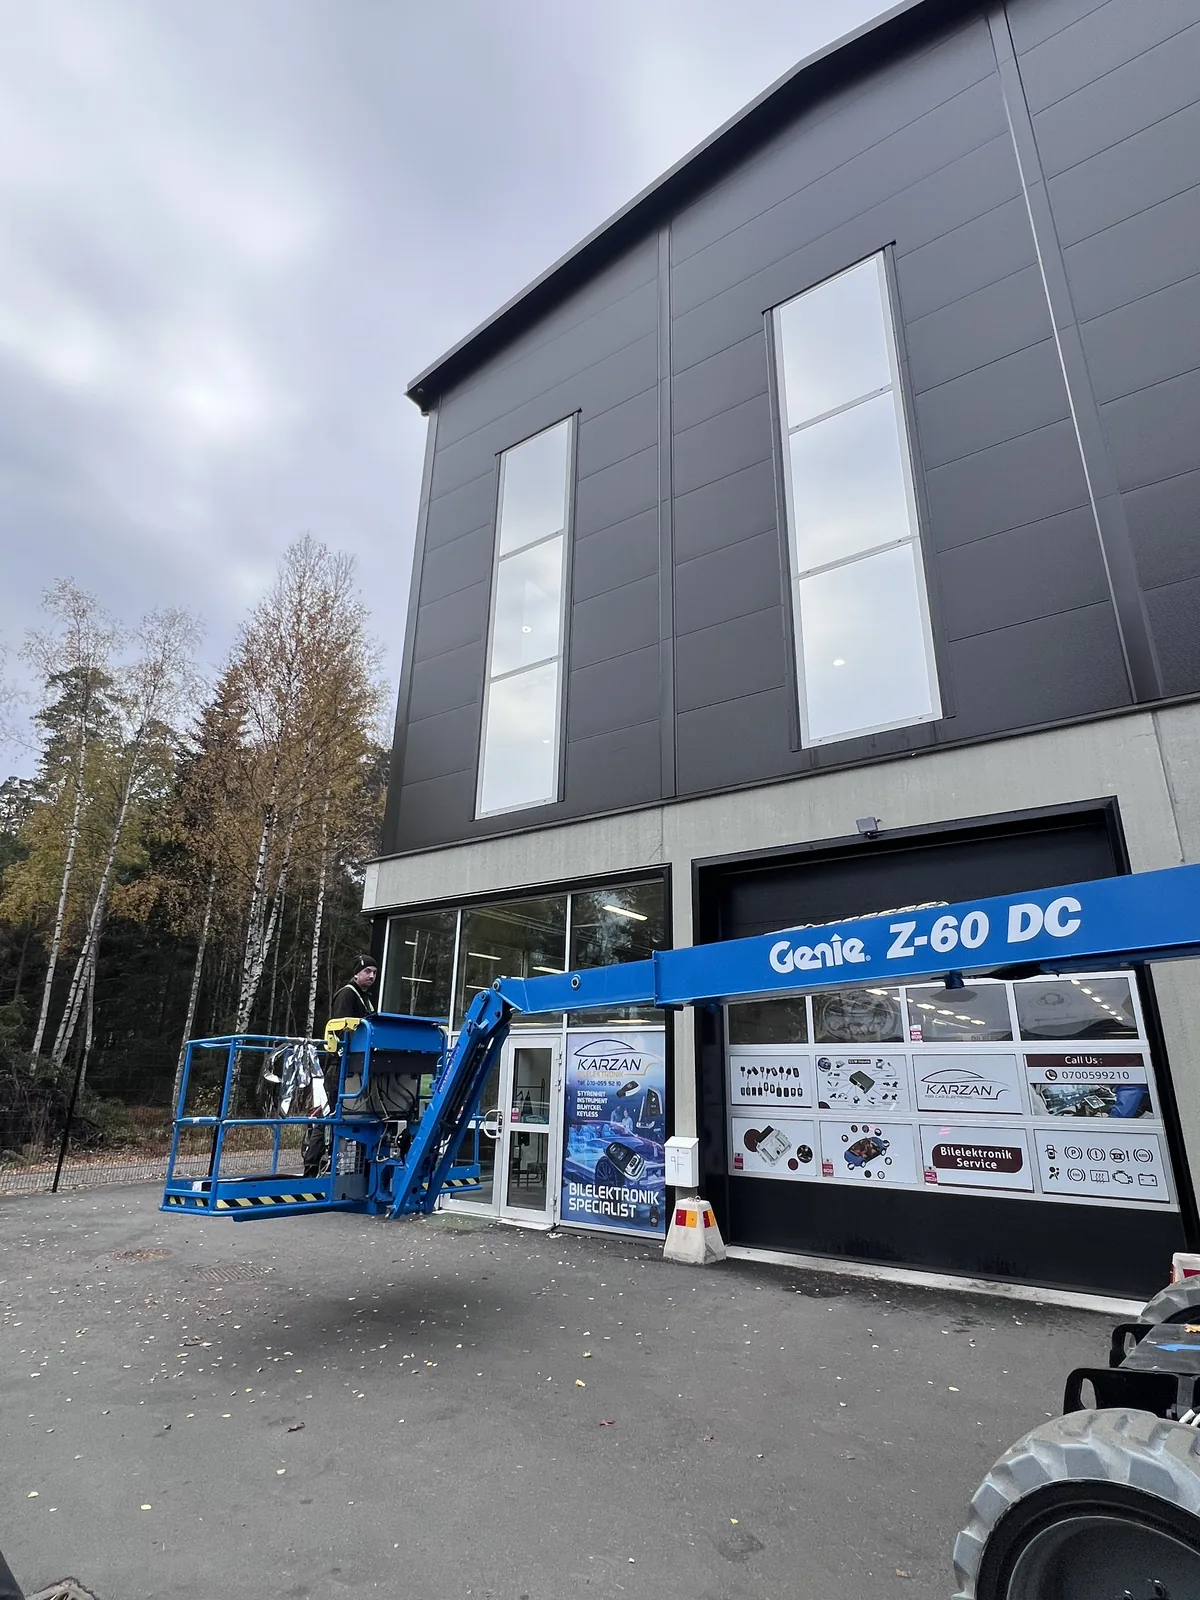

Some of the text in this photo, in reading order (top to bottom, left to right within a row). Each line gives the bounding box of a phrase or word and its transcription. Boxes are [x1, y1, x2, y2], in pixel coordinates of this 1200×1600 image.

[769, 896, 1082, 974] Genie Z-60 DC
[577, 1058, 642, 1071] KARZAN
[1064, 1056, 1083, 1065] Call
[1061, 1071, 1130, 1080] 0700599210
[926, 1084, 992, 1096] KARZAN
[940, 1146, 1013, 1160] Bilelektronik
[956, 1157, 998, 1169] Service
[569, 1182, 660, 1206] BILELEKTRONIK
[568, 1197, 637, 1218] SPECIALIST
